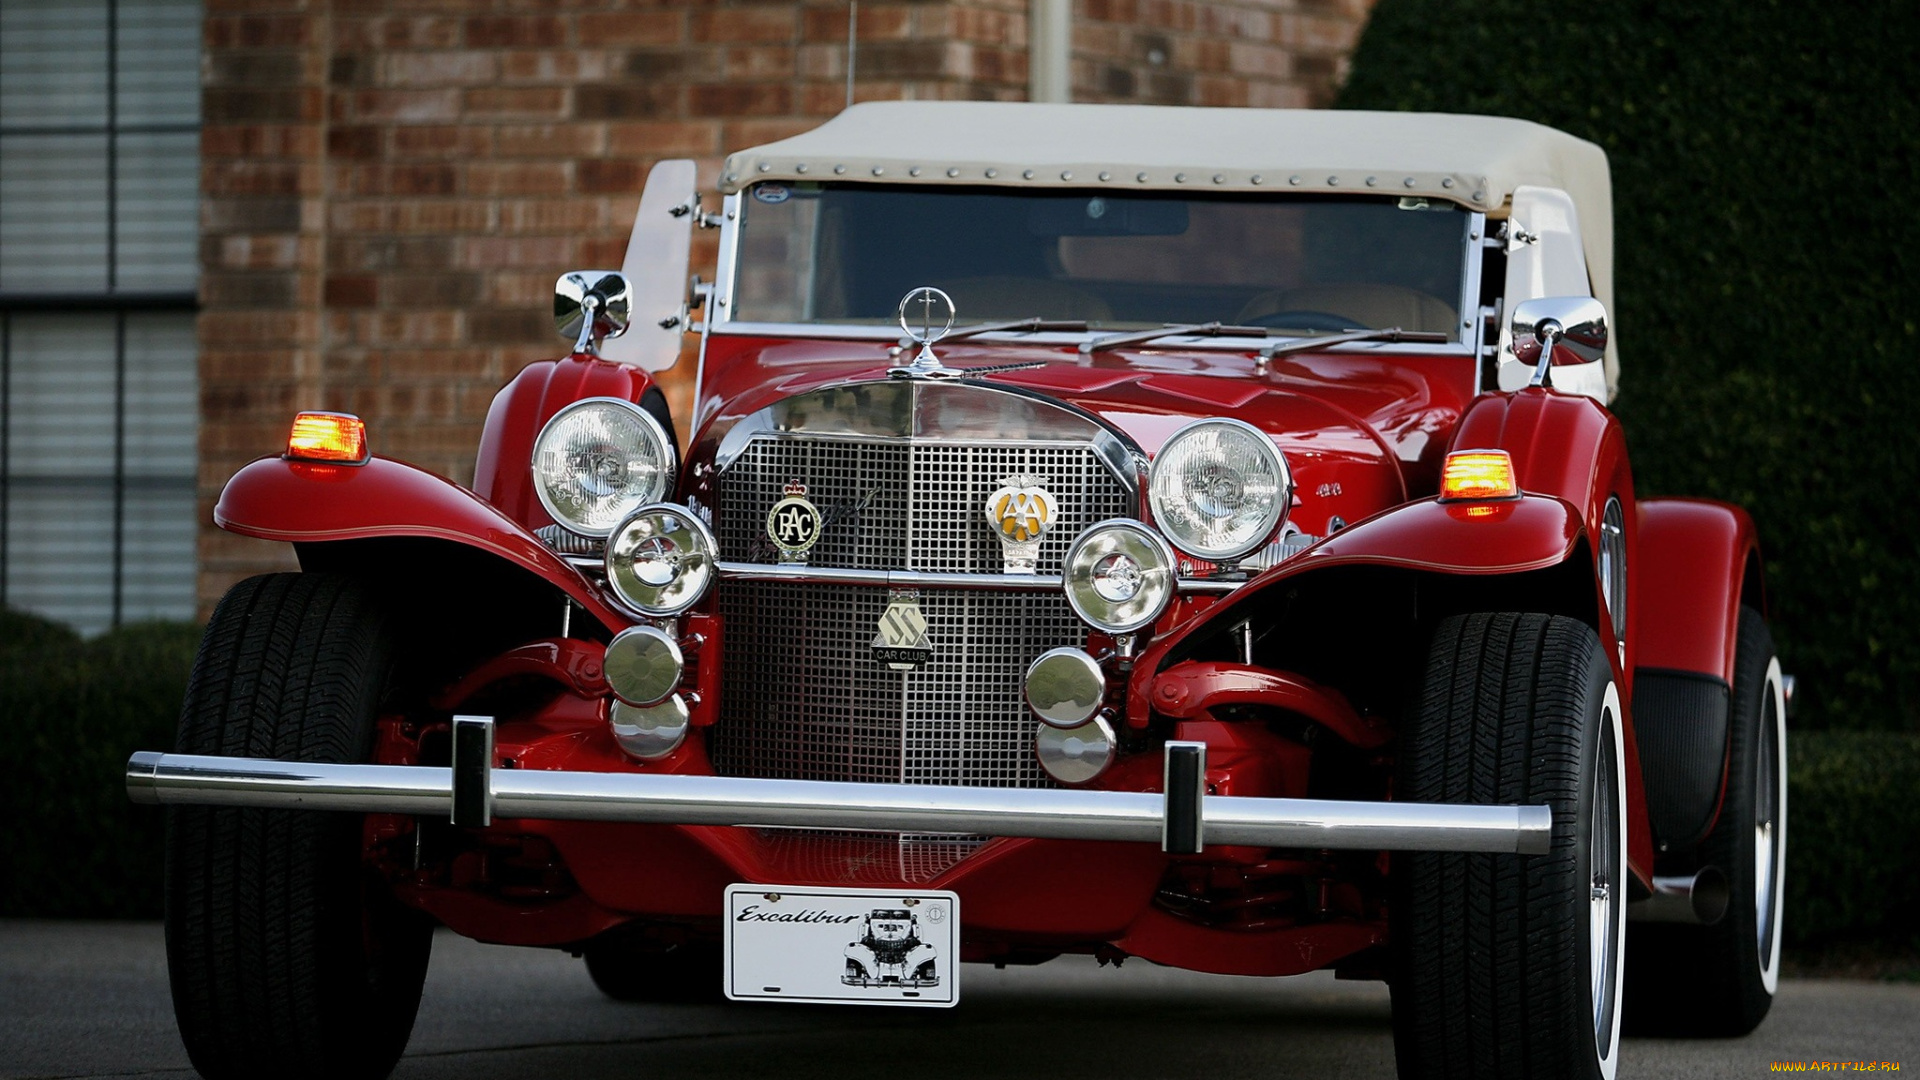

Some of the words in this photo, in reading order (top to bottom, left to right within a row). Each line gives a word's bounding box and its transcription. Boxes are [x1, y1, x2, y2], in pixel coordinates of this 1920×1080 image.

[778, 507, 811, 541] RAC
[998, 492, 1045, 538] AA
[876, 650, 898, 660] CAR
[900, 651, 926, 661] CLUB
[736, 905, 860, 924] Excalibur
